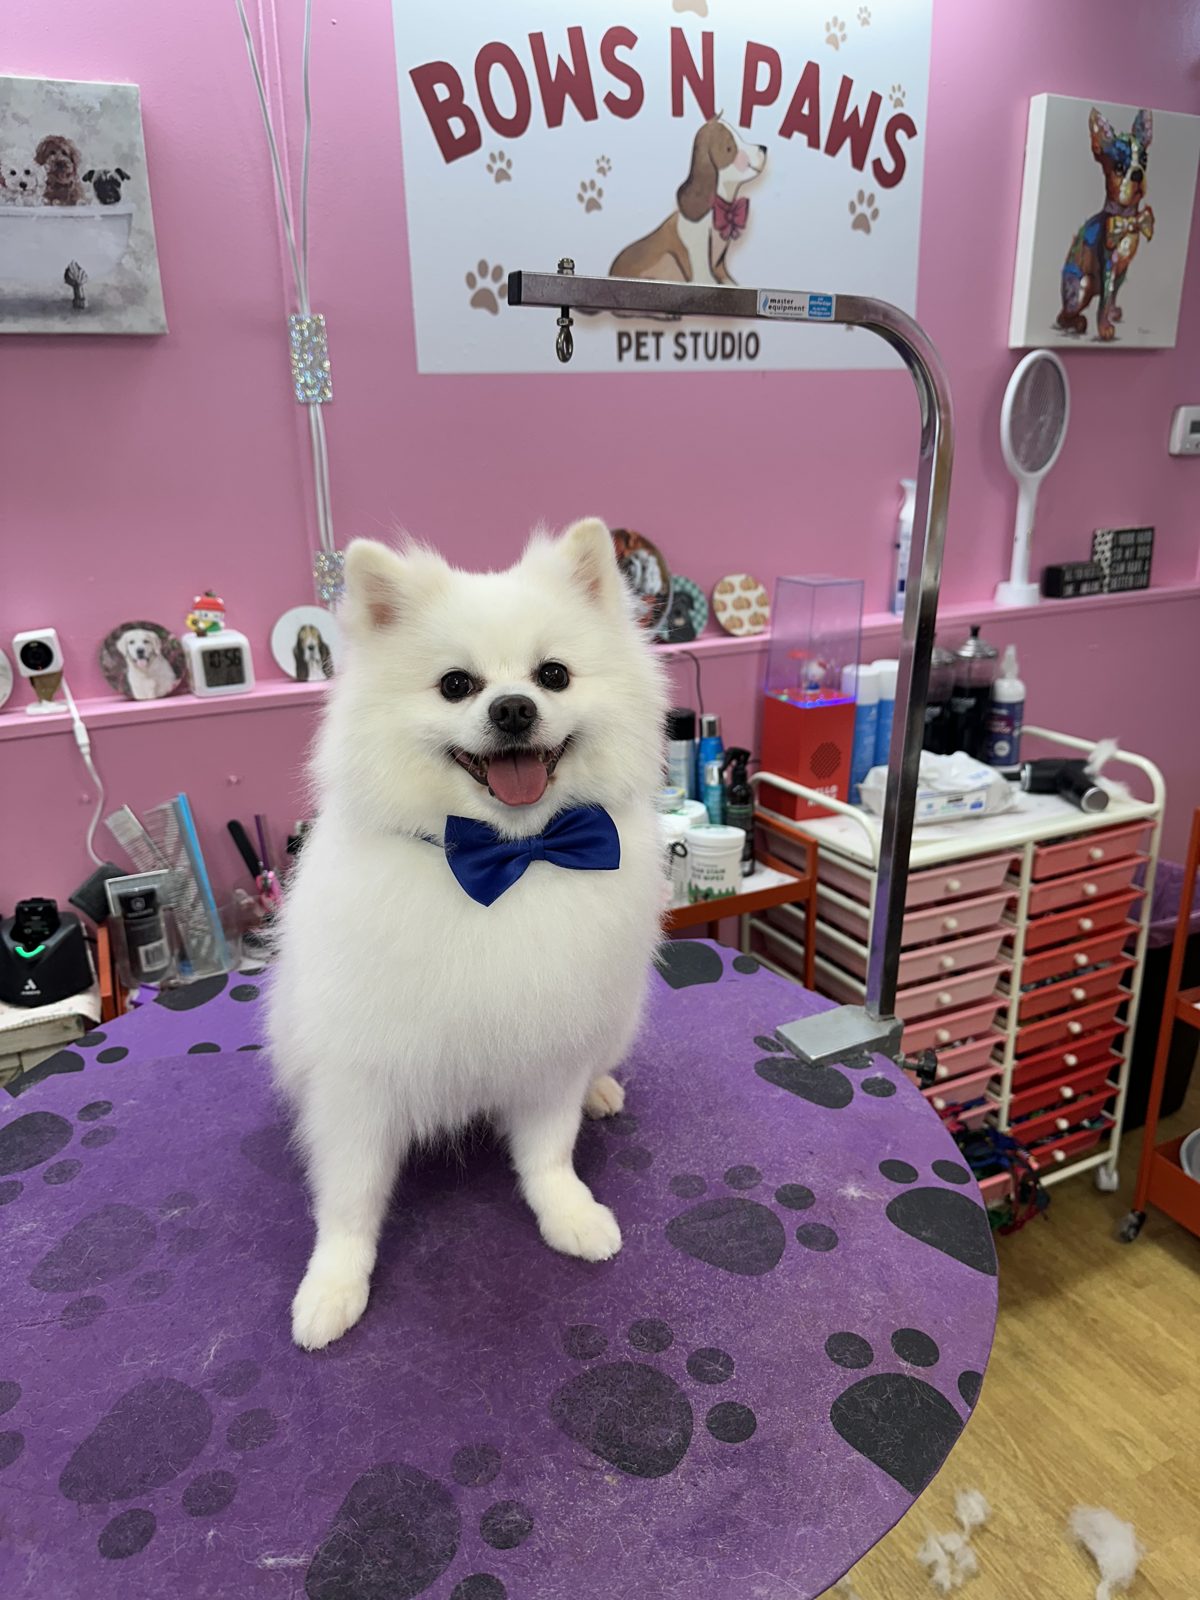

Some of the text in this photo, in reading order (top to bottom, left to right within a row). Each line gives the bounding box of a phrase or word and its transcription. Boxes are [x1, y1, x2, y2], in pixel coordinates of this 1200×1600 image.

[408, 26, 918, 189] BOWS N PAWS
[617, 331, 760, 362] PET STUDIO
